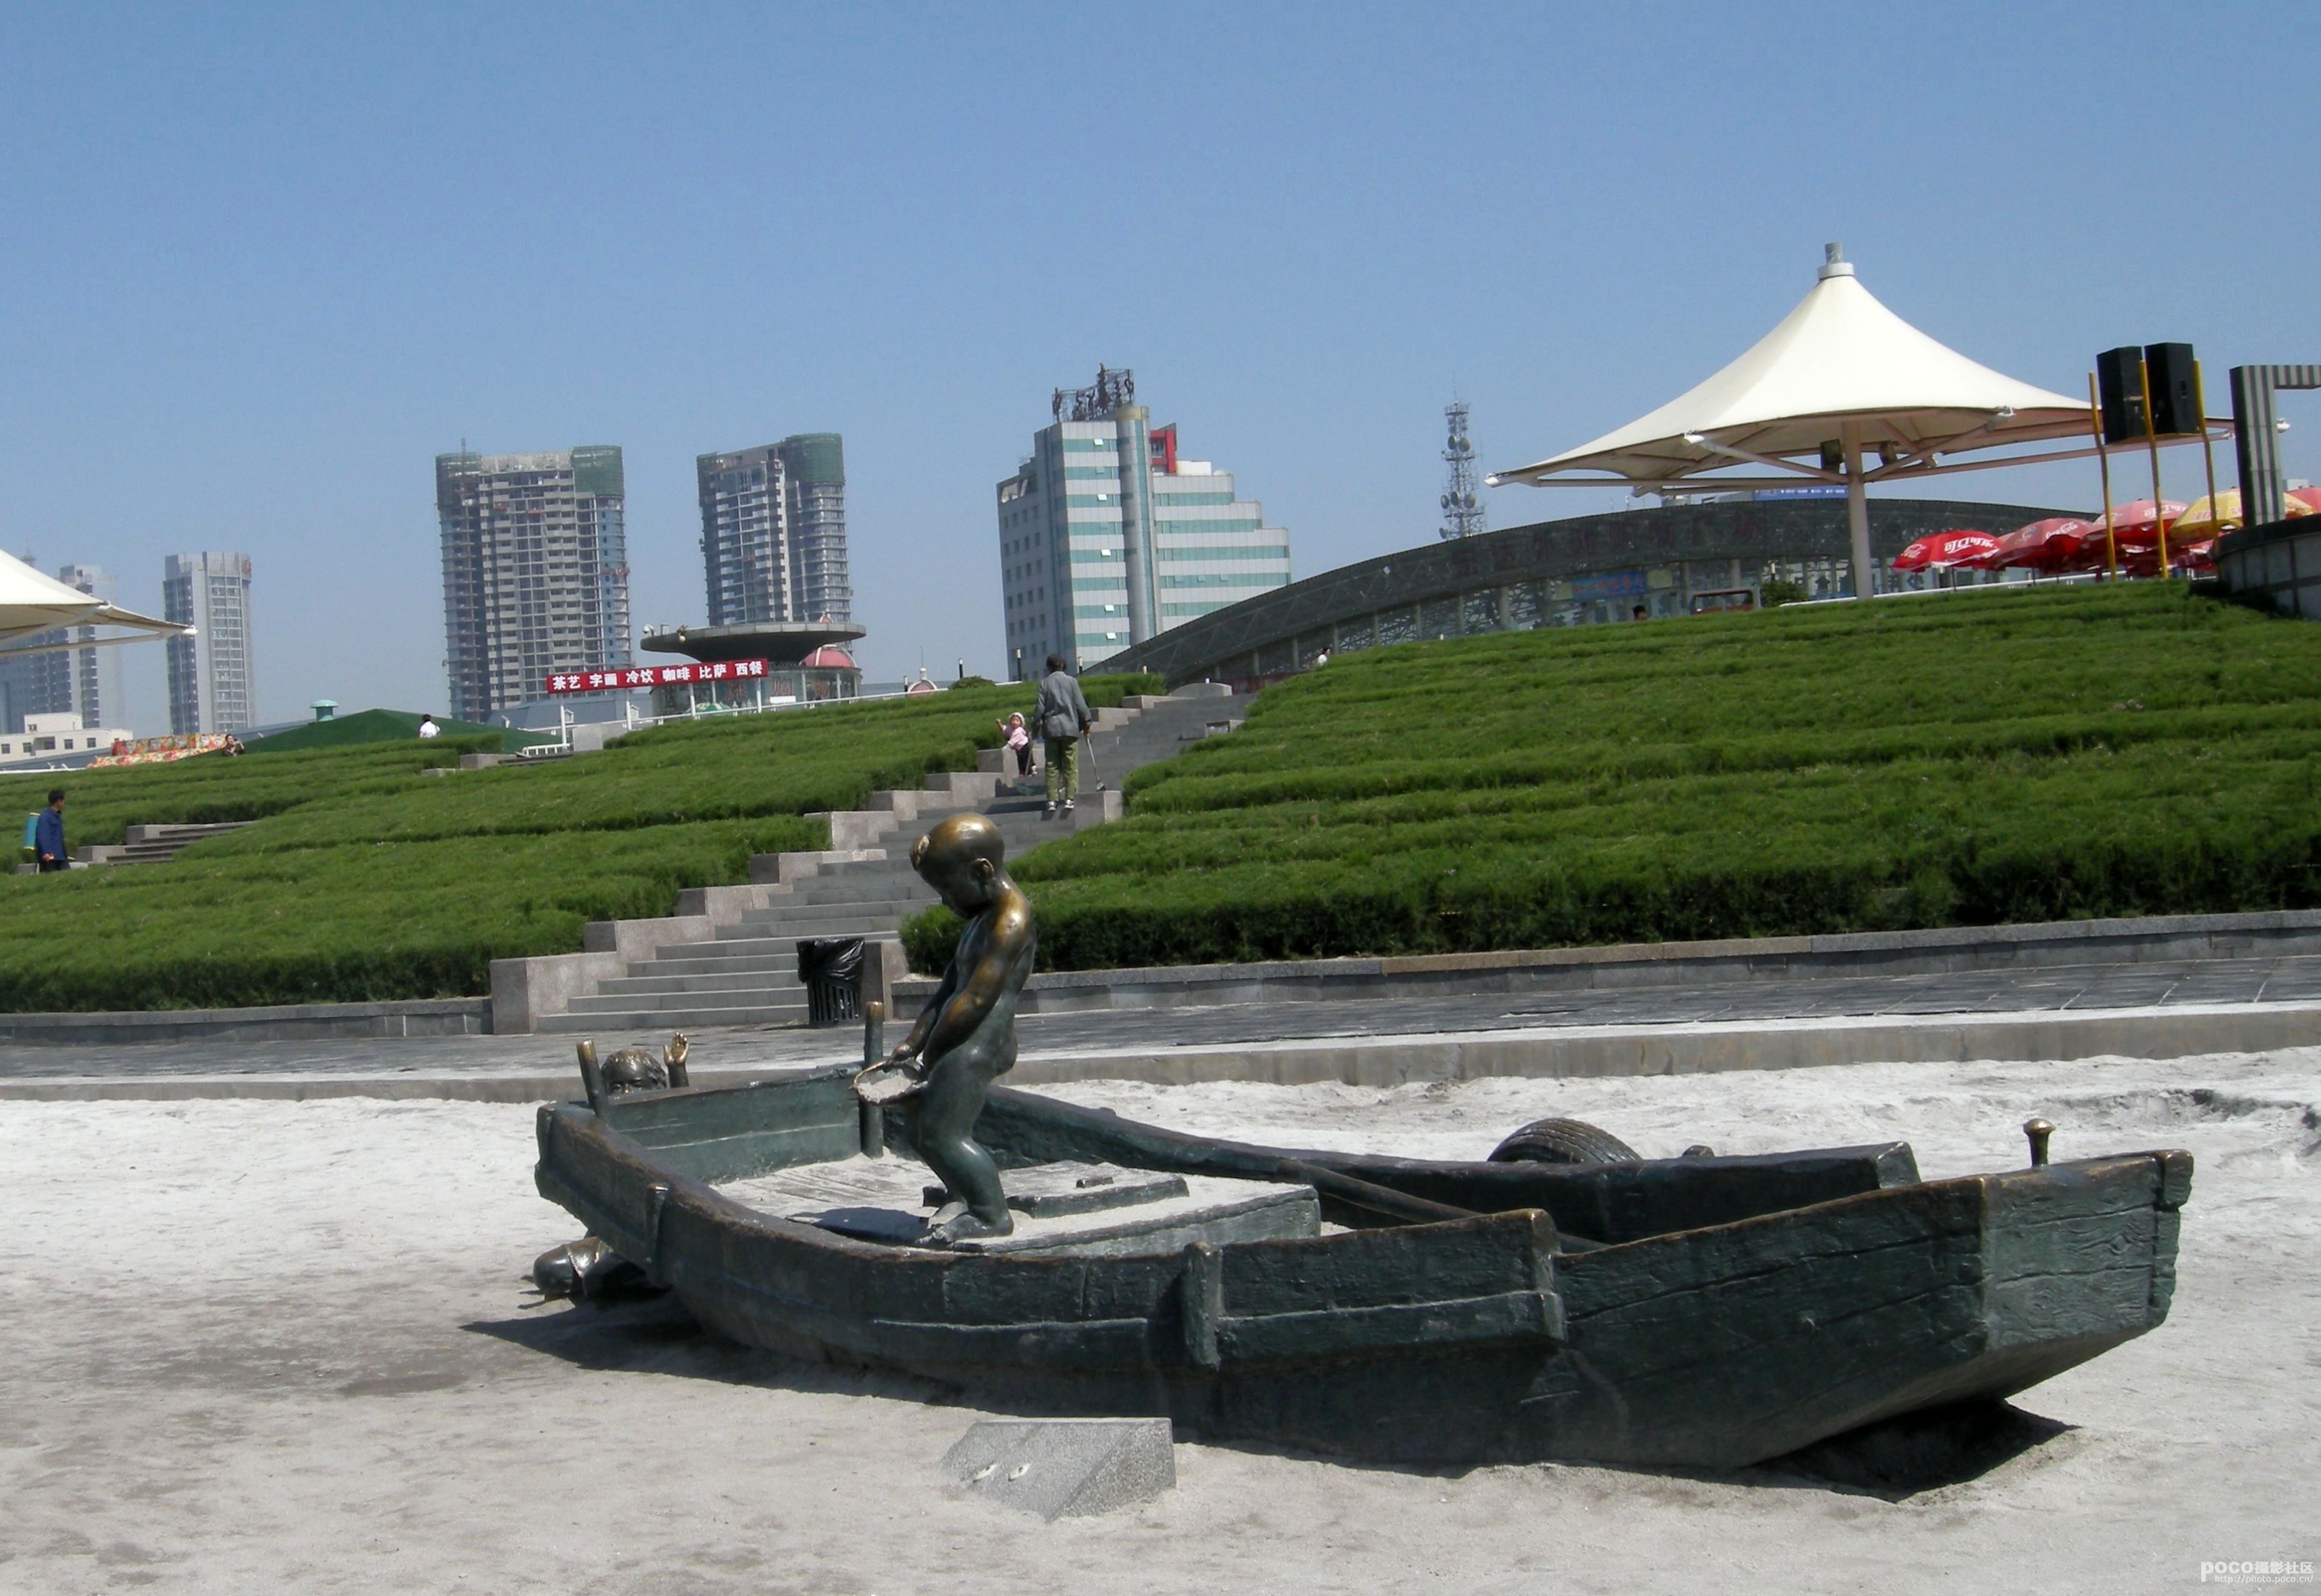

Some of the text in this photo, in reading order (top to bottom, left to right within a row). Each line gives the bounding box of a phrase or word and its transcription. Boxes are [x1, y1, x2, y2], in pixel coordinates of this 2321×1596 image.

[1944, 537, 1994, 554] 可口可乐
[552, 661, 762, 690] 茶艺 字画 冷饮 咖啡 比萨 西餐
